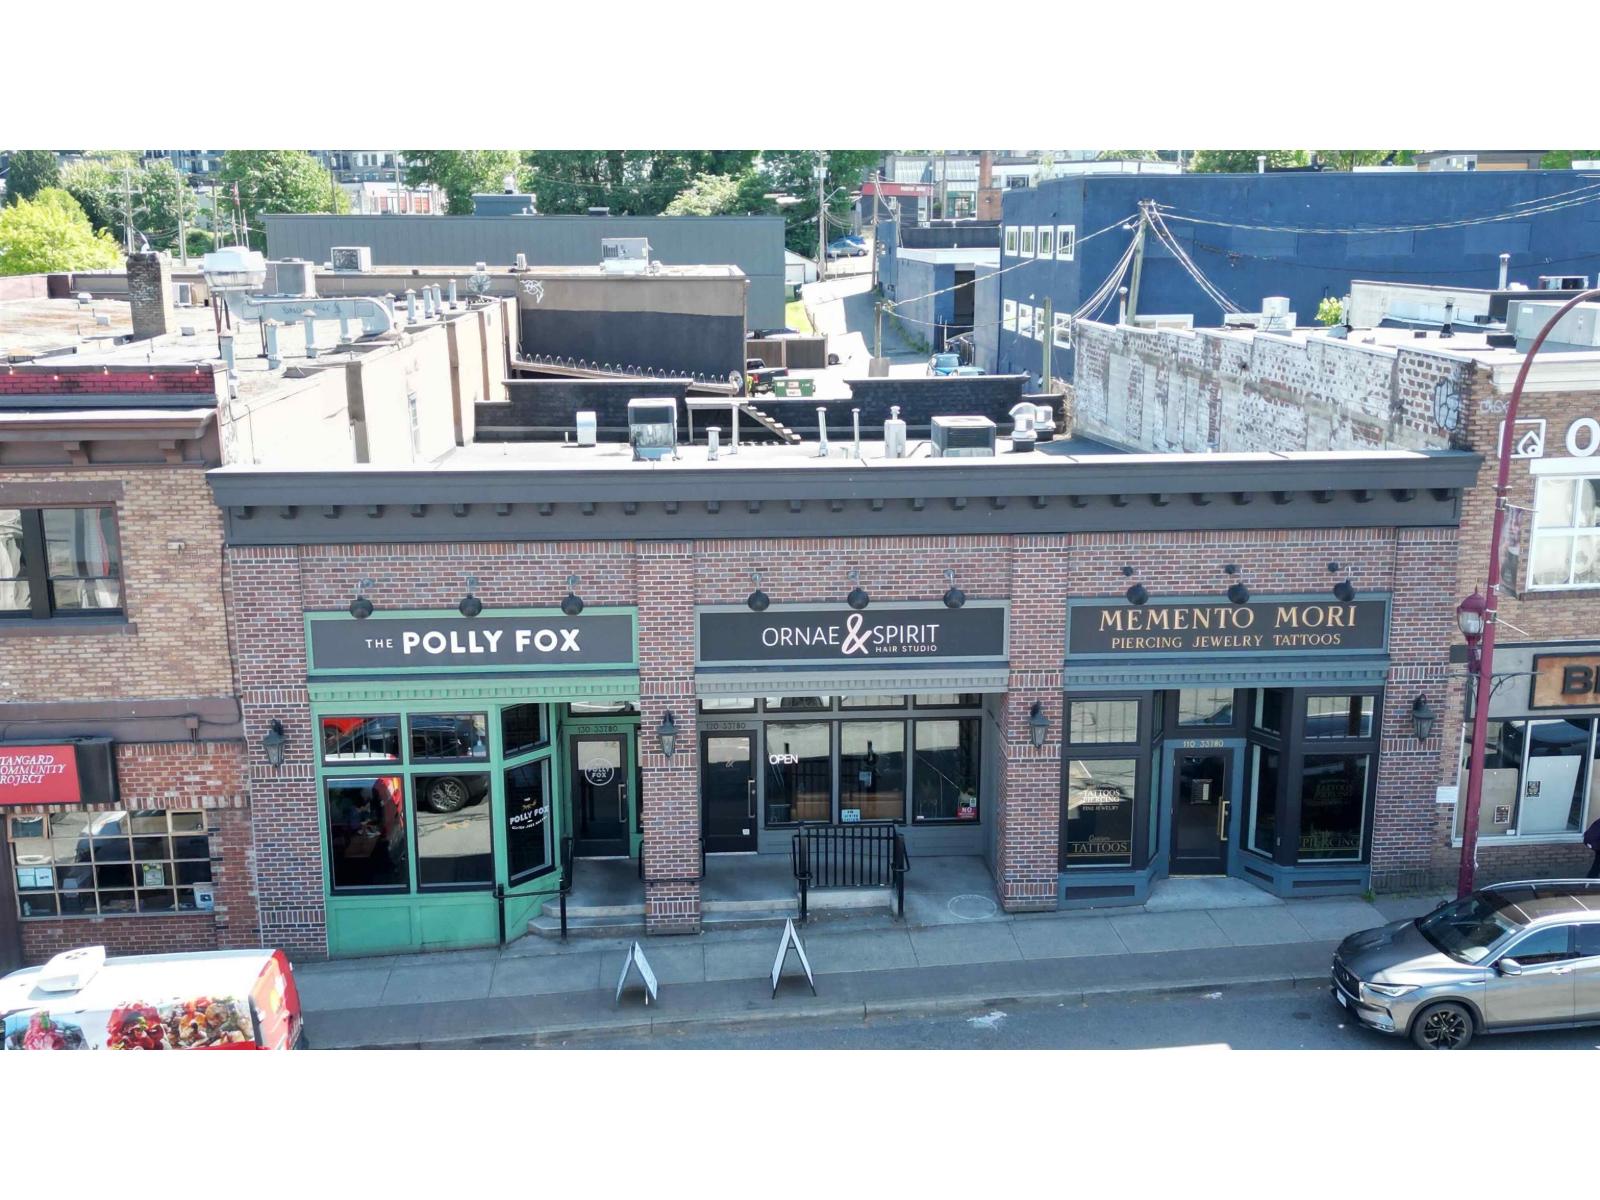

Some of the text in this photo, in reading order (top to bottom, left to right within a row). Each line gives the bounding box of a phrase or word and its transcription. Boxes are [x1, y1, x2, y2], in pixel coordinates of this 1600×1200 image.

[1099, 605, 1357, 631] MEMENTO MORI
[365, 628, 581, 654] THE POLLY FOX
[762, 613, 940, 655] ORNAE & SPIRIT
[1111, 633, 1341, 649] PIERCING JEWELRY TATTOOS
[1562, 665, 1600, 695] B
[769, 754, 799, 765] OPEN
[1082, 789, 1120, 797] TATTOOS
[510, 810, 533, 825] POLLY
[534, 804, 549, 817] FOX
[1072, 842, 1128, 853] TATTOOS
